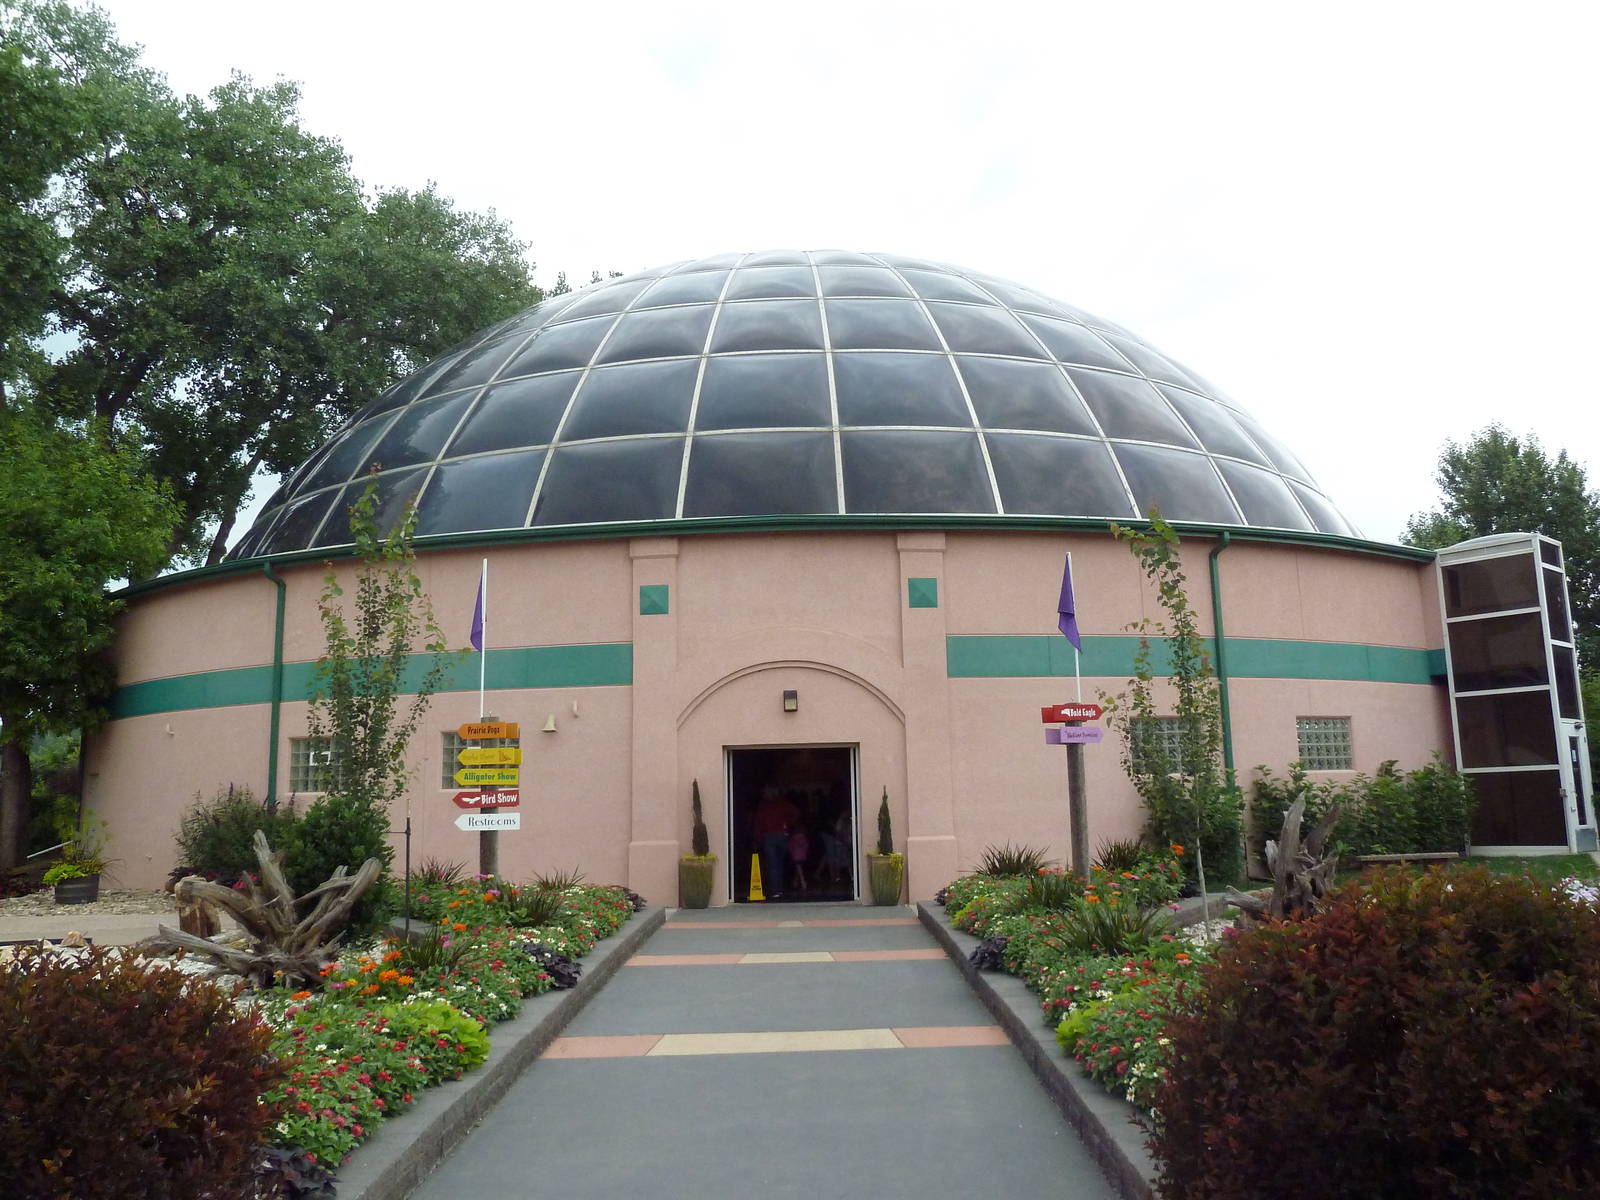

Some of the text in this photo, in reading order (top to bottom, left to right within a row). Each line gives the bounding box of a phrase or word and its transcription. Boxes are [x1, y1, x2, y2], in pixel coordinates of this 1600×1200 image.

[467, 725, 486, 735] Prairie
[464, 772, 495, 782] Alligator
[481, 793, 518, 805] Bird Show
[468, 816, 516, 827] Restrooms
